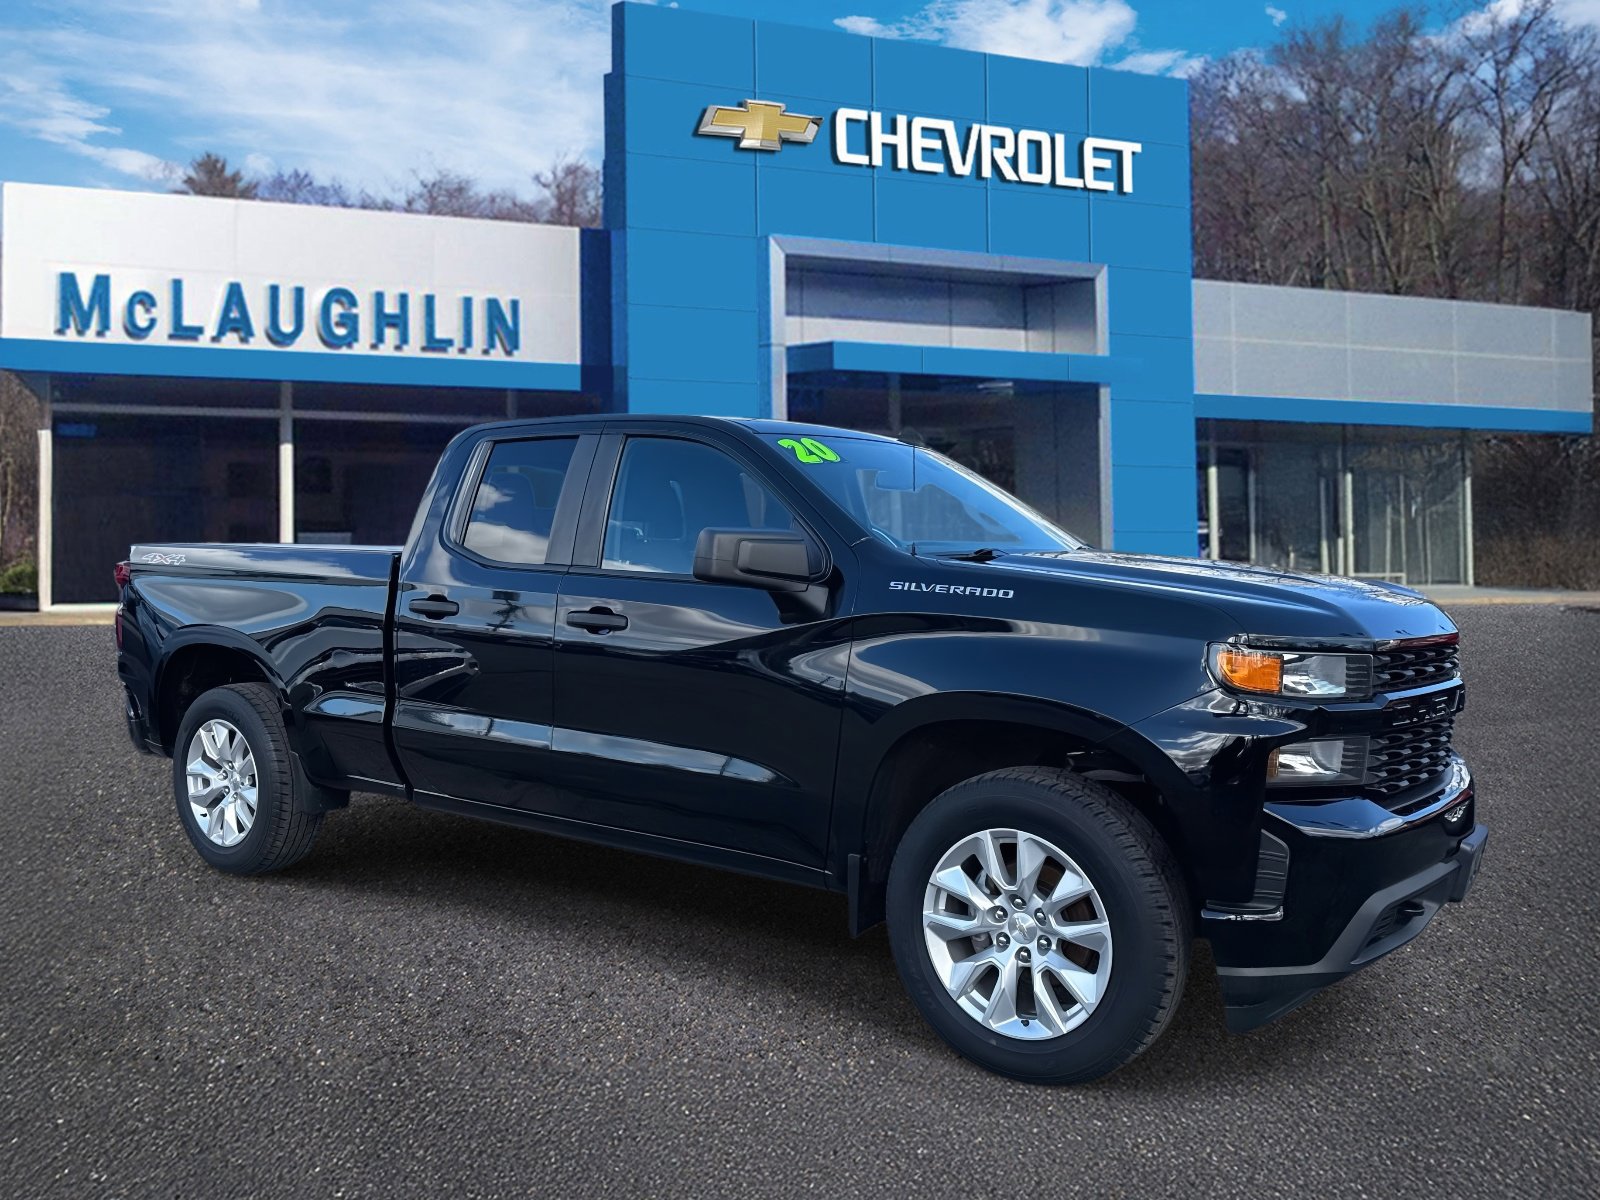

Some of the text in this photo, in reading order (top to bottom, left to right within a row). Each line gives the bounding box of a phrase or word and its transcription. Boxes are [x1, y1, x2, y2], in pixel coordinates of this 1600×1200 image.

[835, 107, 1142, 194] CHEVROLET
[55, 271, 521, 357] McLAUGHLIN
[777, 437, 841, 464] 20
[888, 580, 1015, 599] SILVERADO
